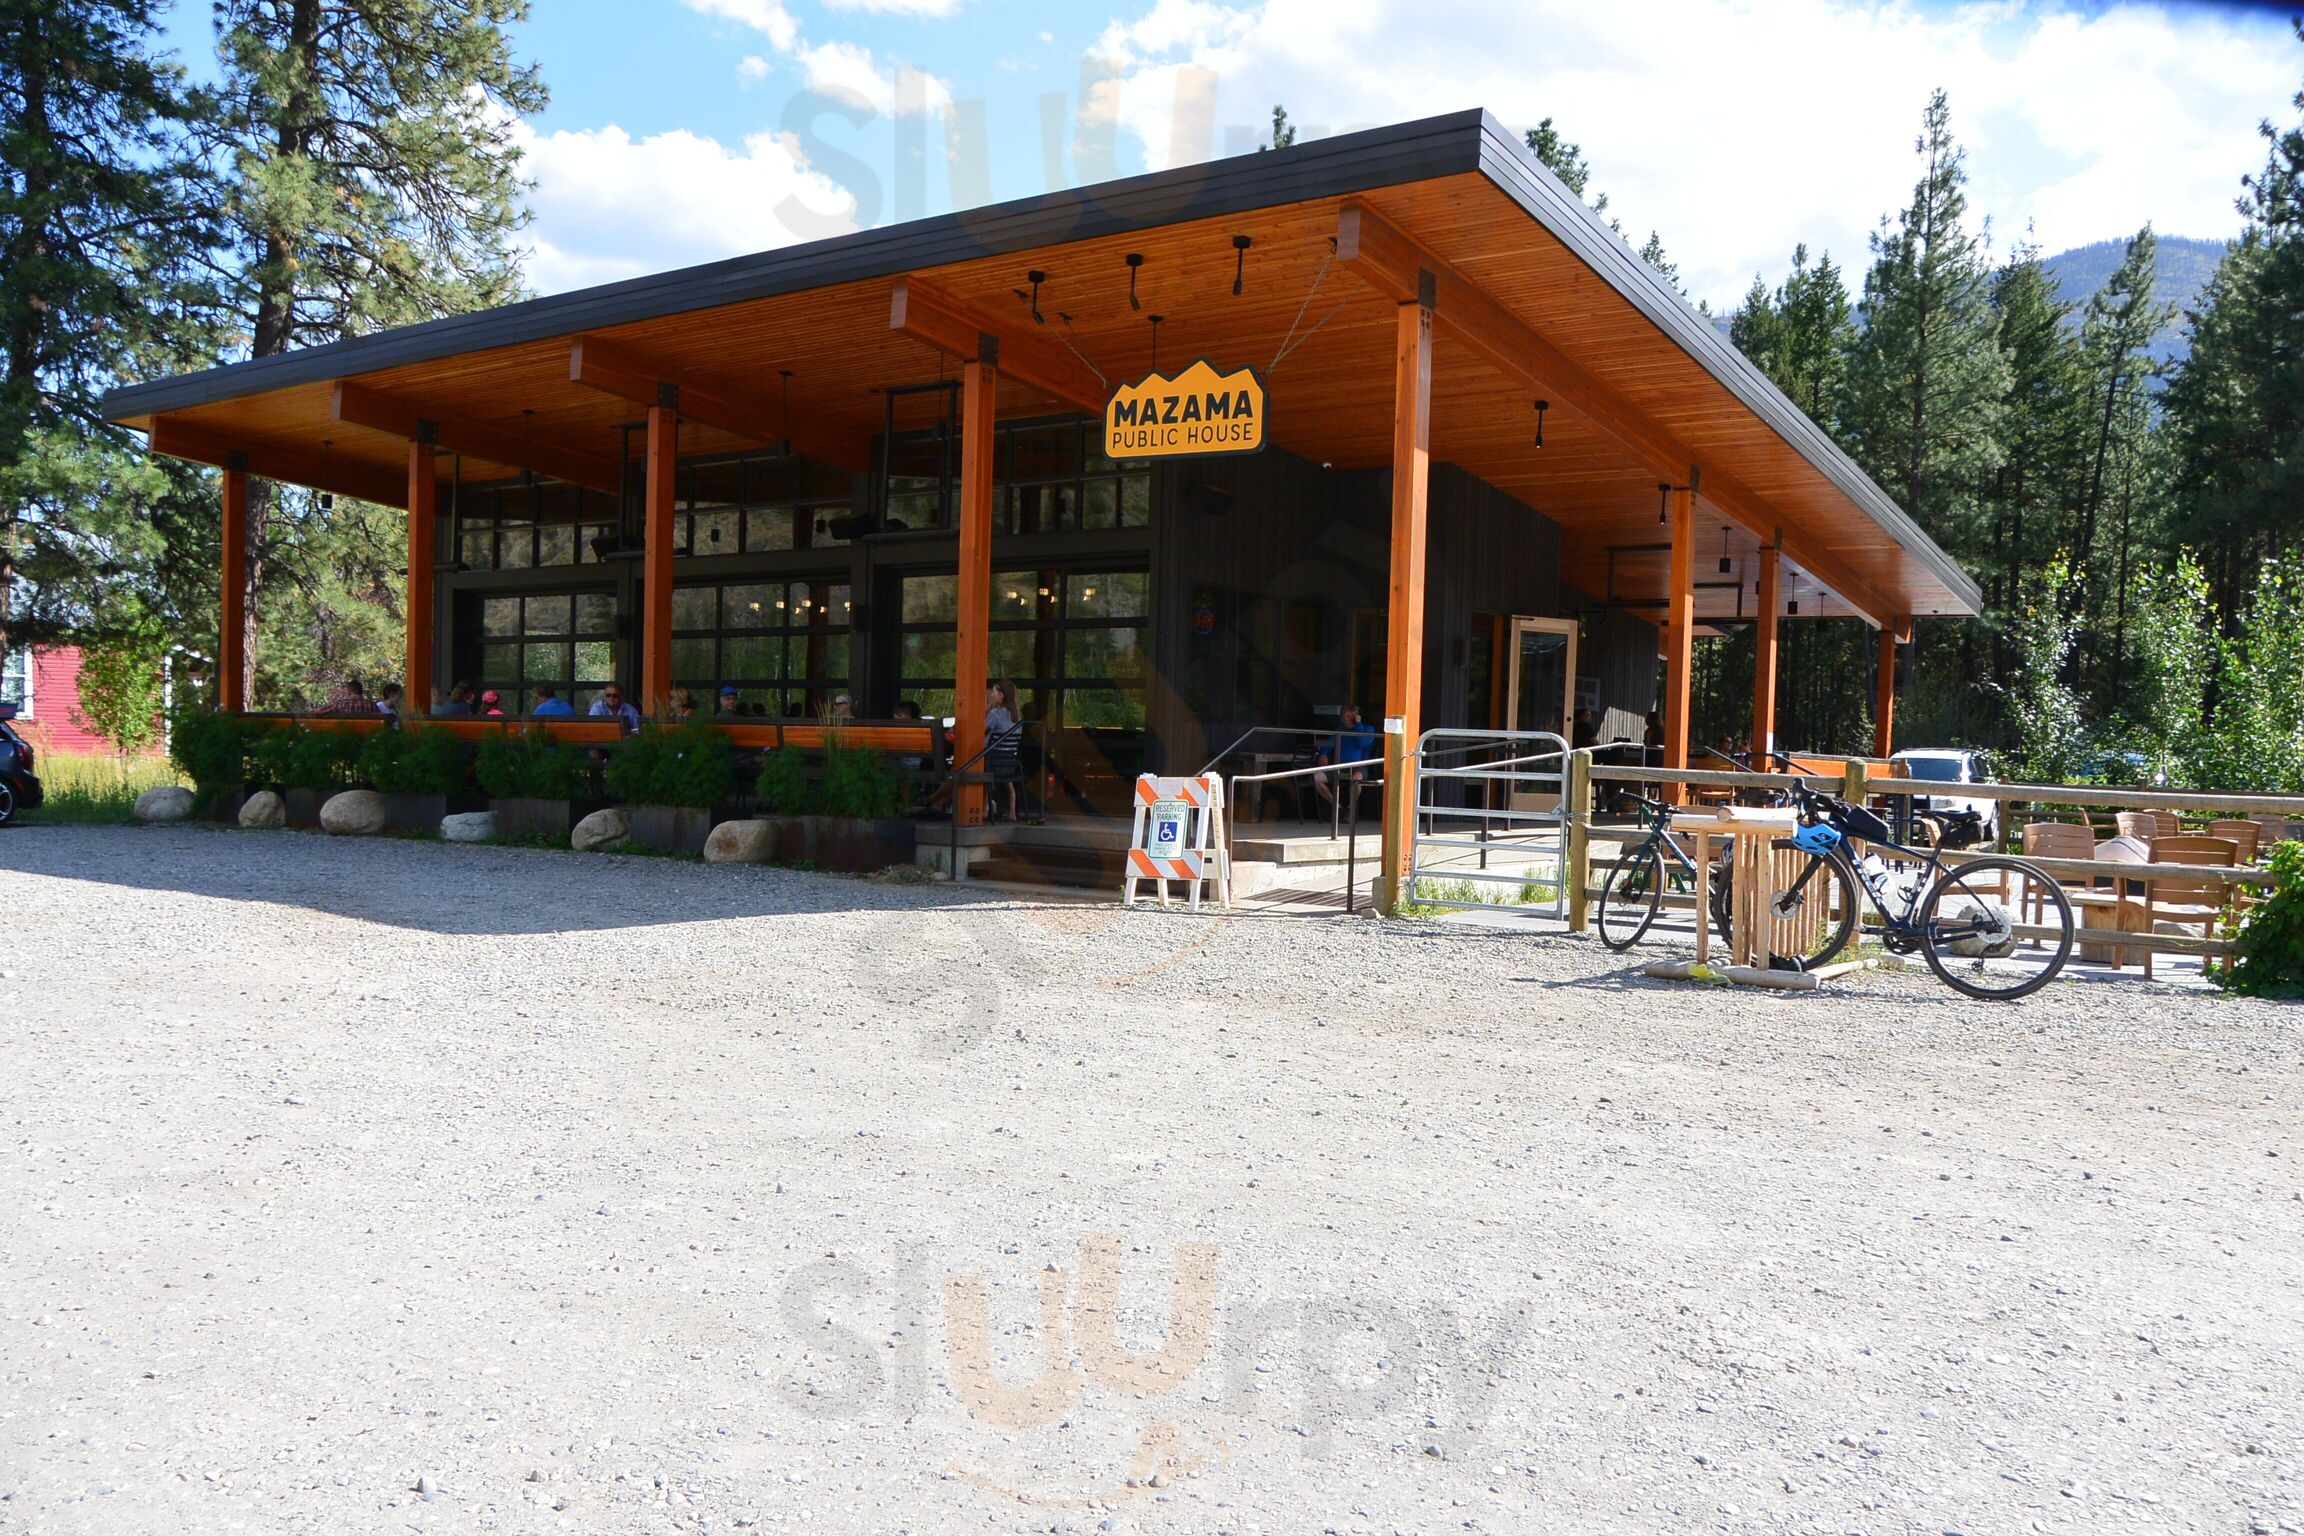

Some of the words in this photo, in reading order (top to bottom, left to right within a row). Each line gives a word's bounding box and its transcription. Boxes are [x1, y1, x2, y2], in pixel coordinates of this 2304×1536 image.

[1114, 390, 1253, 427] MAZAMA
[1112, 428, 1178, 449] PUBLIC
[1187, 423, 1253, 444] HOUSE
[1156, 804, 1185, 812] RESERVED
